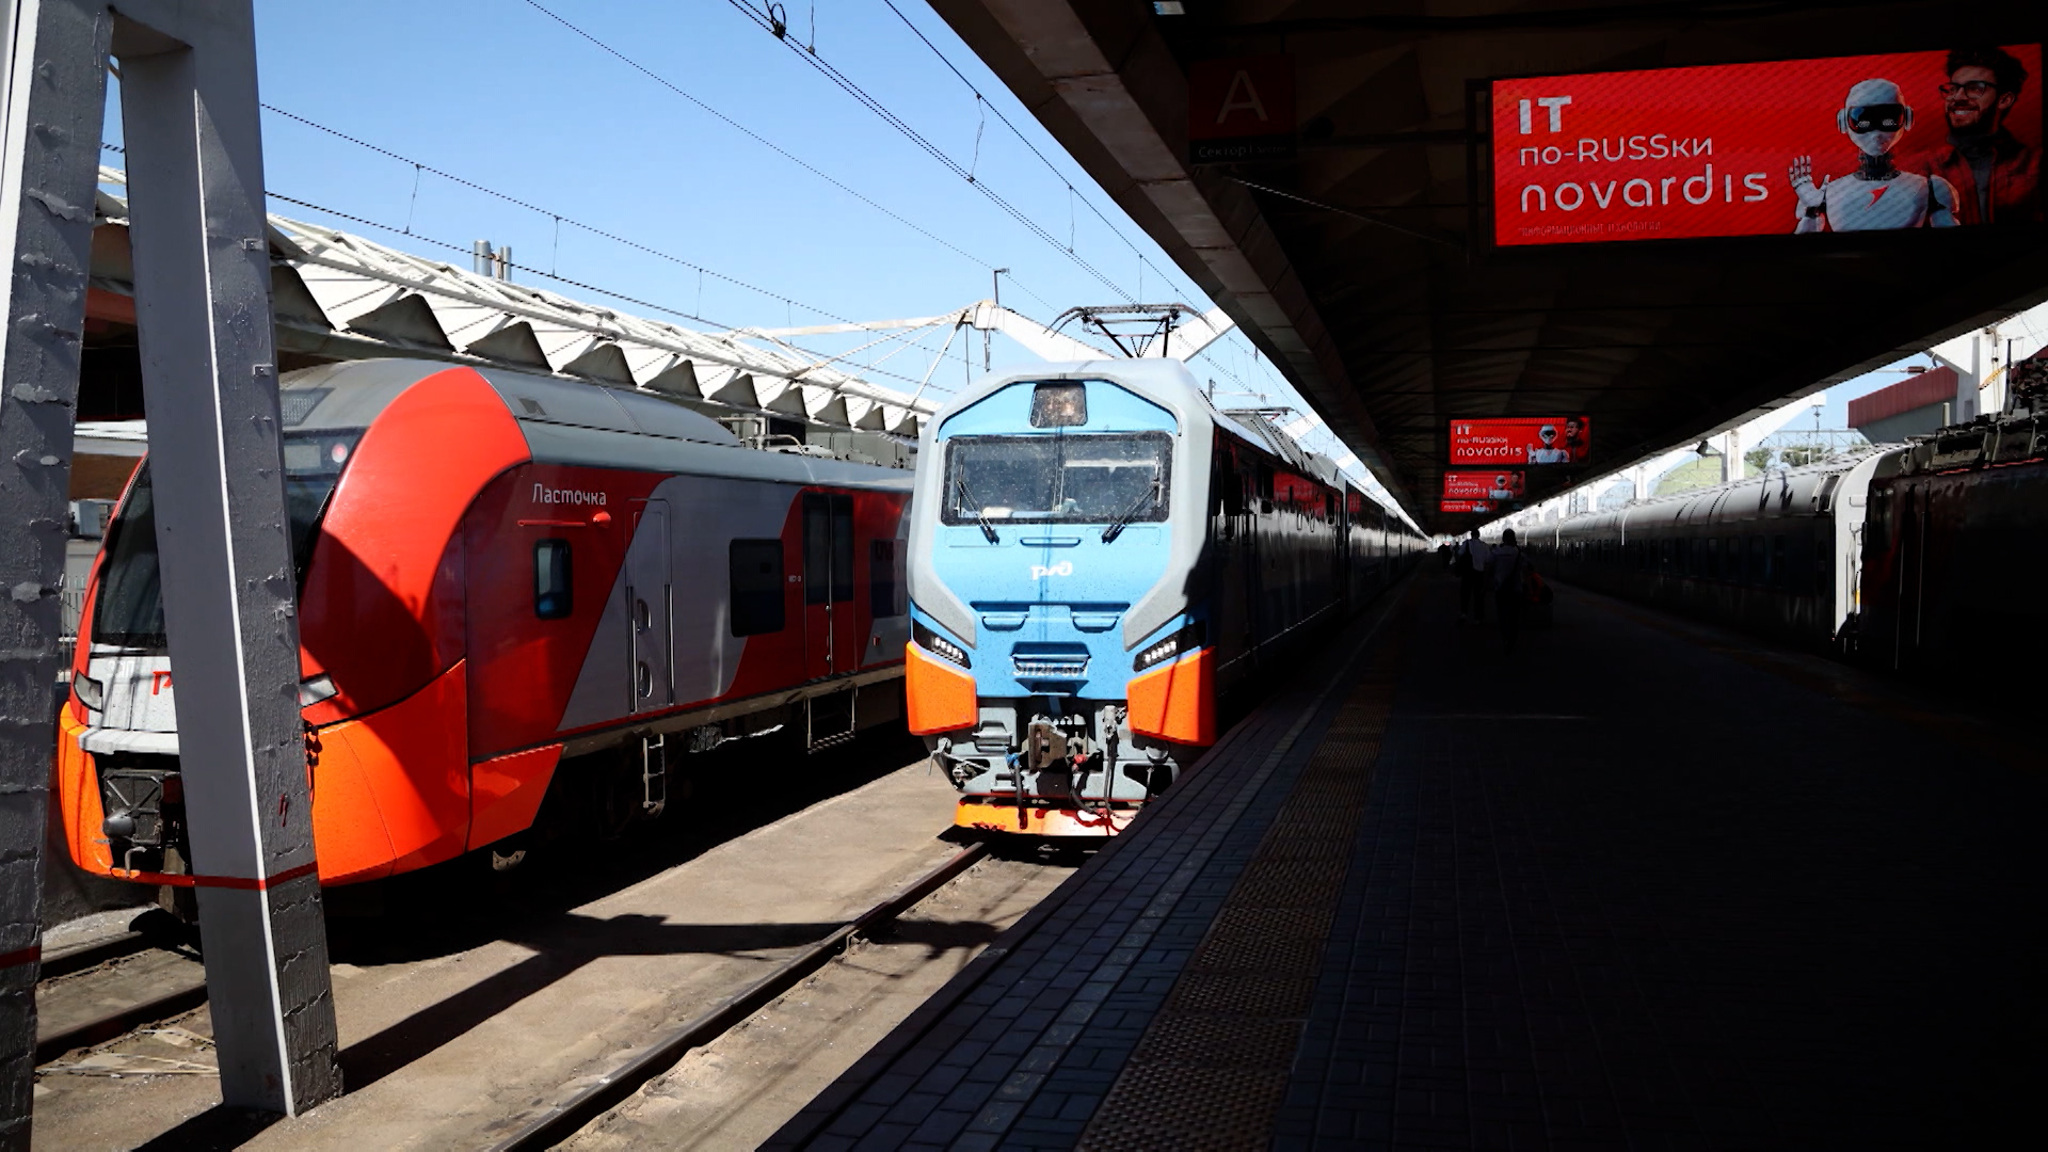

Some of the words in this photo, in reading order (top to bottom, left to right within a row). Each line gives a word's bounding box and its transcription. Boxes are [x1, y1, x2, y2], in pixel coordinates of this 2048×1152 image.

[1216, 70, 1269, 124] А
[1519, 95, 1572, 134] IT
[1520, 134, 1713, 165] по-RUSSки
[1520, 164, 1768, 213] novardis
[1457, 424, 1472, 435] IT
[1457, 444, 1522, 456] novardis
[532, 483, 606, 506] Ласточка
